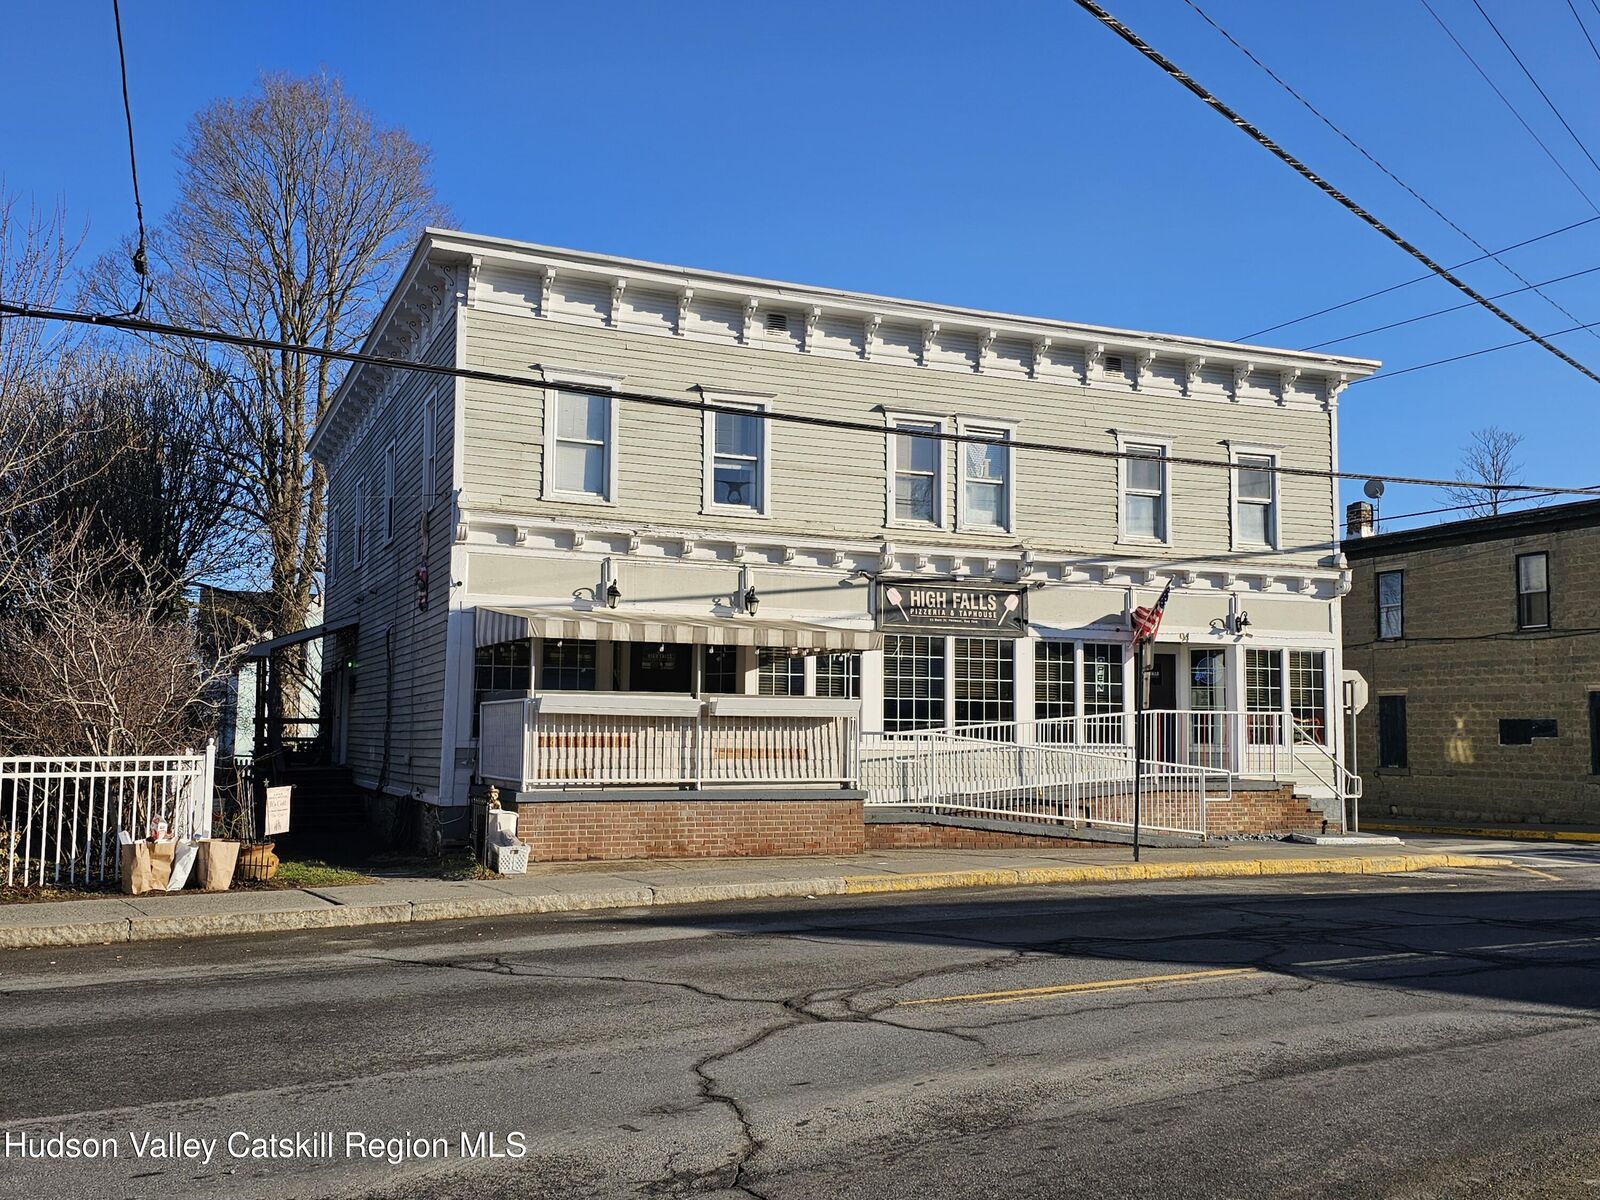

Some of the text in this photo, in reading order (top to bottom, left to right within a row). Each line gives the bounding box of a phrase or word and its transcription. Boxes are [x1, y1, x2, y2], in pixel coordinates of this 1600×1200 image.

[910, 590, 997, 611] HIGH FALLS
[910, 608, 946, 616] PIZZERIA
[959, 610, 997, 618] TAPHOUSE
